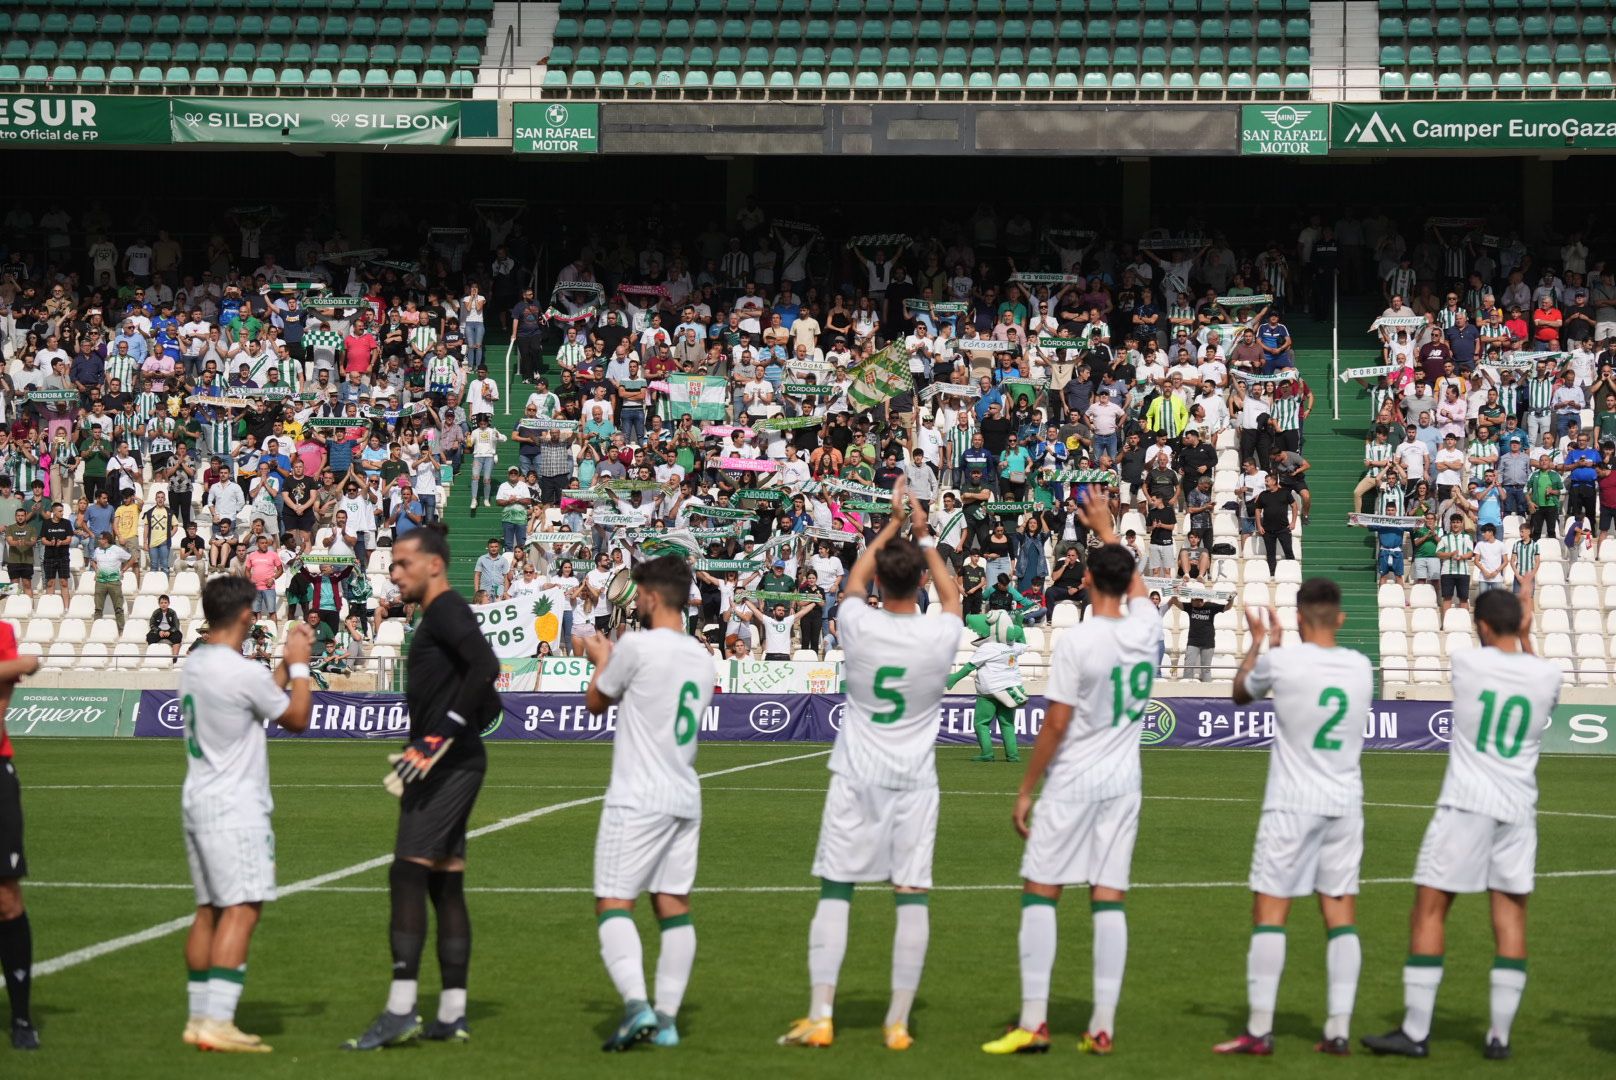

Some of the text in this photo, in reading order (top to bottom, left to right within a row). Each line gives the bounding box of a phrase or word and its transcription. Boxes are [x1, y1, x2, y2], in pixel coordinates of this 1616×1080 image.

[208, 112, 300, 128] SILBON
[355, 114, 449, 130] SILBON
[1277, 113, 1295, 122] MINI
[20, 129, 60, 140] Oficial
[63, 130, 79, 140] de
[82, 130, 99, 140] FP
[516, 128, 595, 139] SAN RAFAEL
[1243, 130, 1327, 142] SAN RAFAEL
[1413, 118, 1616, 141] Camper EuroGaza
[532, 140, 578, 151] MOTOR
[1260, 142, 1310, 154] MOTOR
[64, 390, 75, 399] CF
[541, 660, 581, 676] LOS
[742, 662, 770, 675] LOS
[871, 665, 908, 724] 5
[1110, 661, 1153, 728] 19
[4, 704, 106, 735] arquero
[559, 705, 720, 731] FEDEN
[674, 681, 700, 746] 6
[1312, 686, 1349, 751] 2
[759, 718, 781, 726] EF
[1234, 707, 1398, 738] FEDÓN
[1475, 690, 1532, 758] 10
